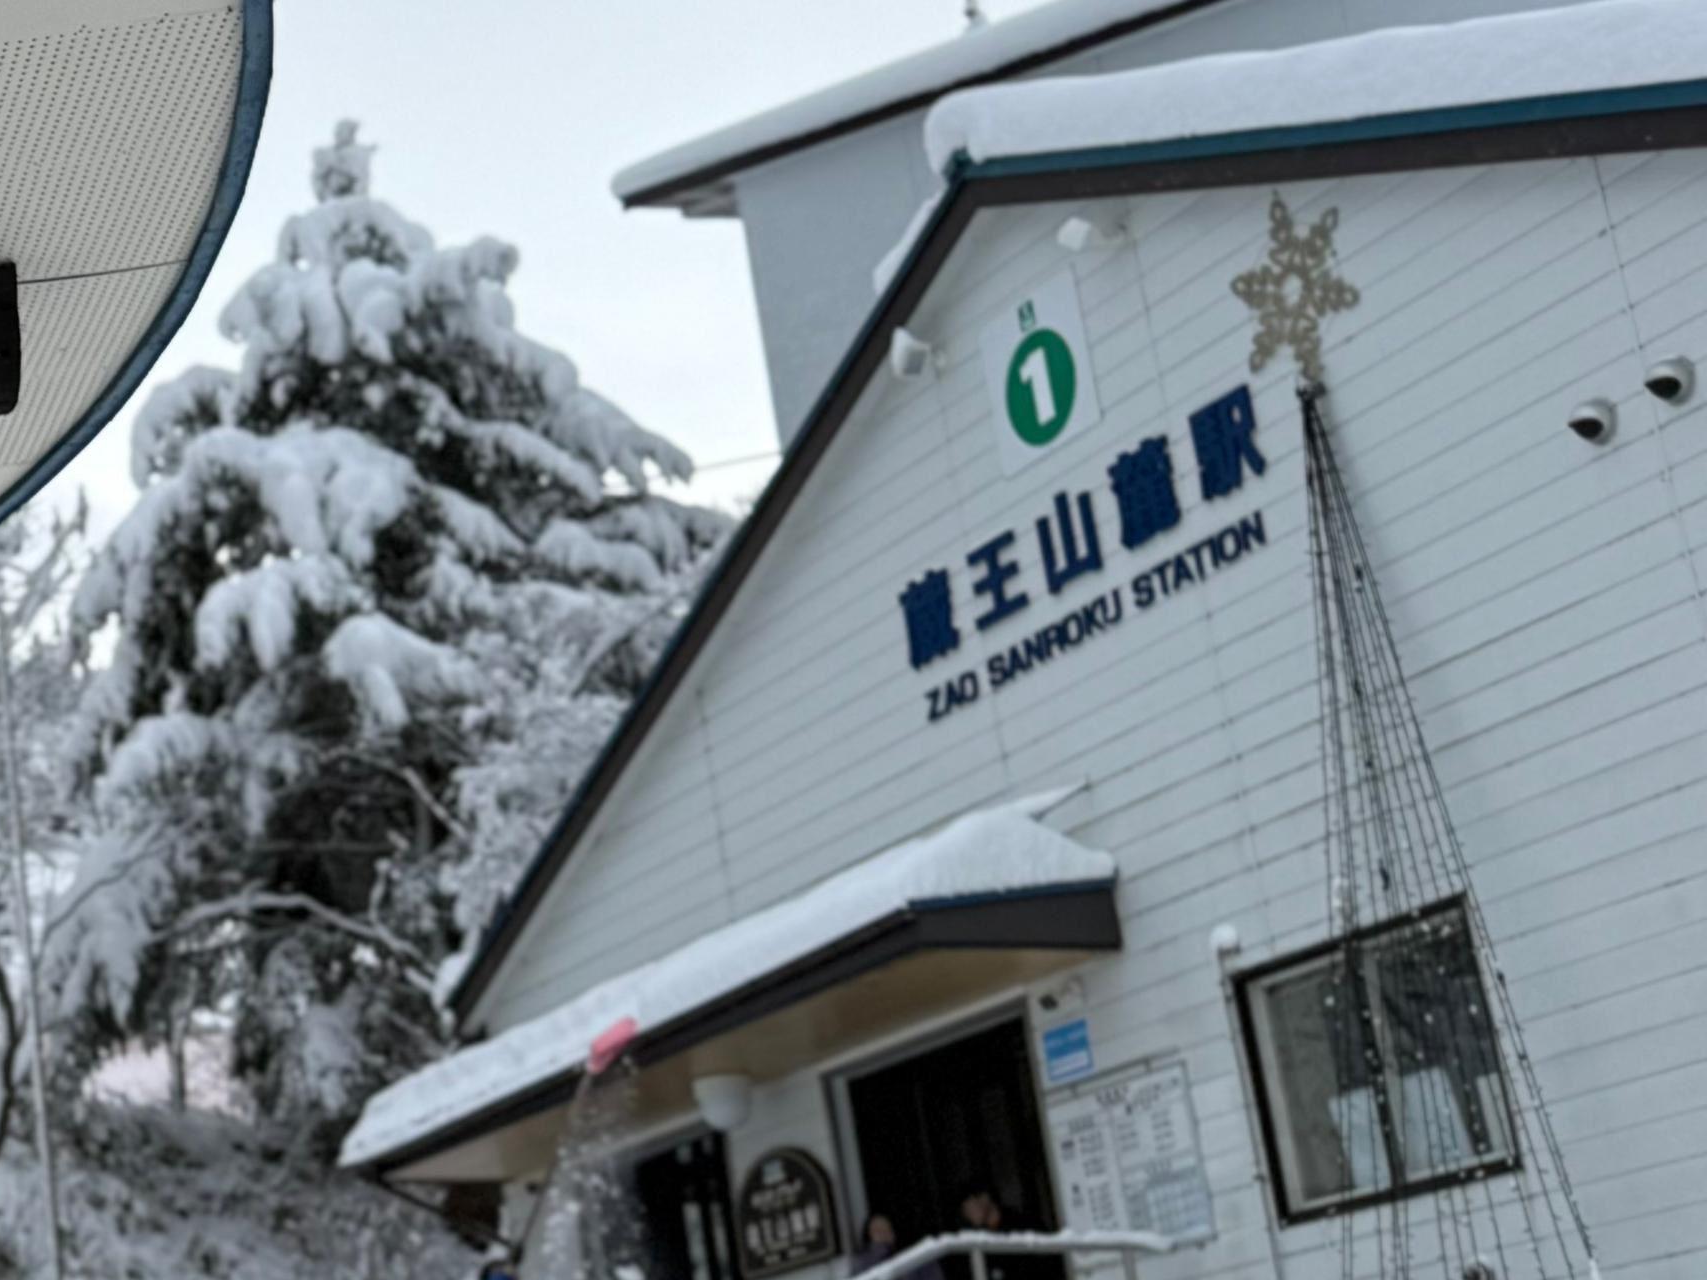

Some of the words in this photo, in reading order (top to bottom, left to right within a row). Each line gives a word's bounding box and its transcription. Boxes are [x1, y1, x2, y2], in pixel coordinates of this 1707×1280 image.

[924, 672, 981, 723] ZAO
[987, 586, 1124, 692] SANROKU
[1135, 510, 1269, 611] STATION
